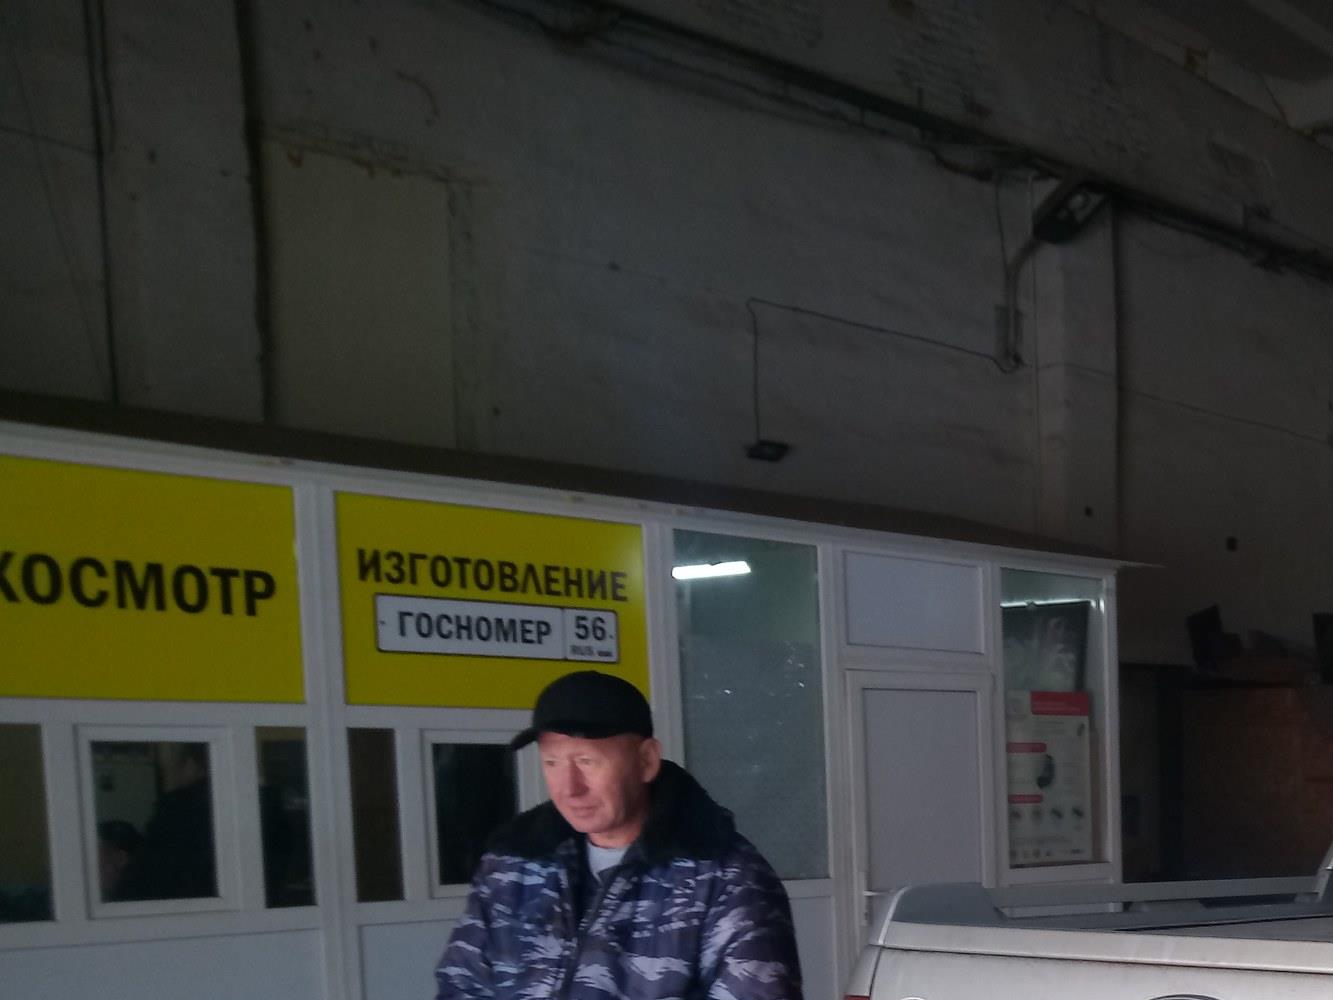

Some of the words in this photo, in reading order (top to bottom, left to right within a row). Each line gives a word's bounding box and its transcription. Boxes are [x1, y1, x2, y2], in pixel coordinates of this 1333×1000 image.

[356, 548, 629, 602] ИЗГОТОВЛЕНИЕ
[397, 610, 552, 645] ГОСНОМЕР
[575, 615, 606, 641] 56
